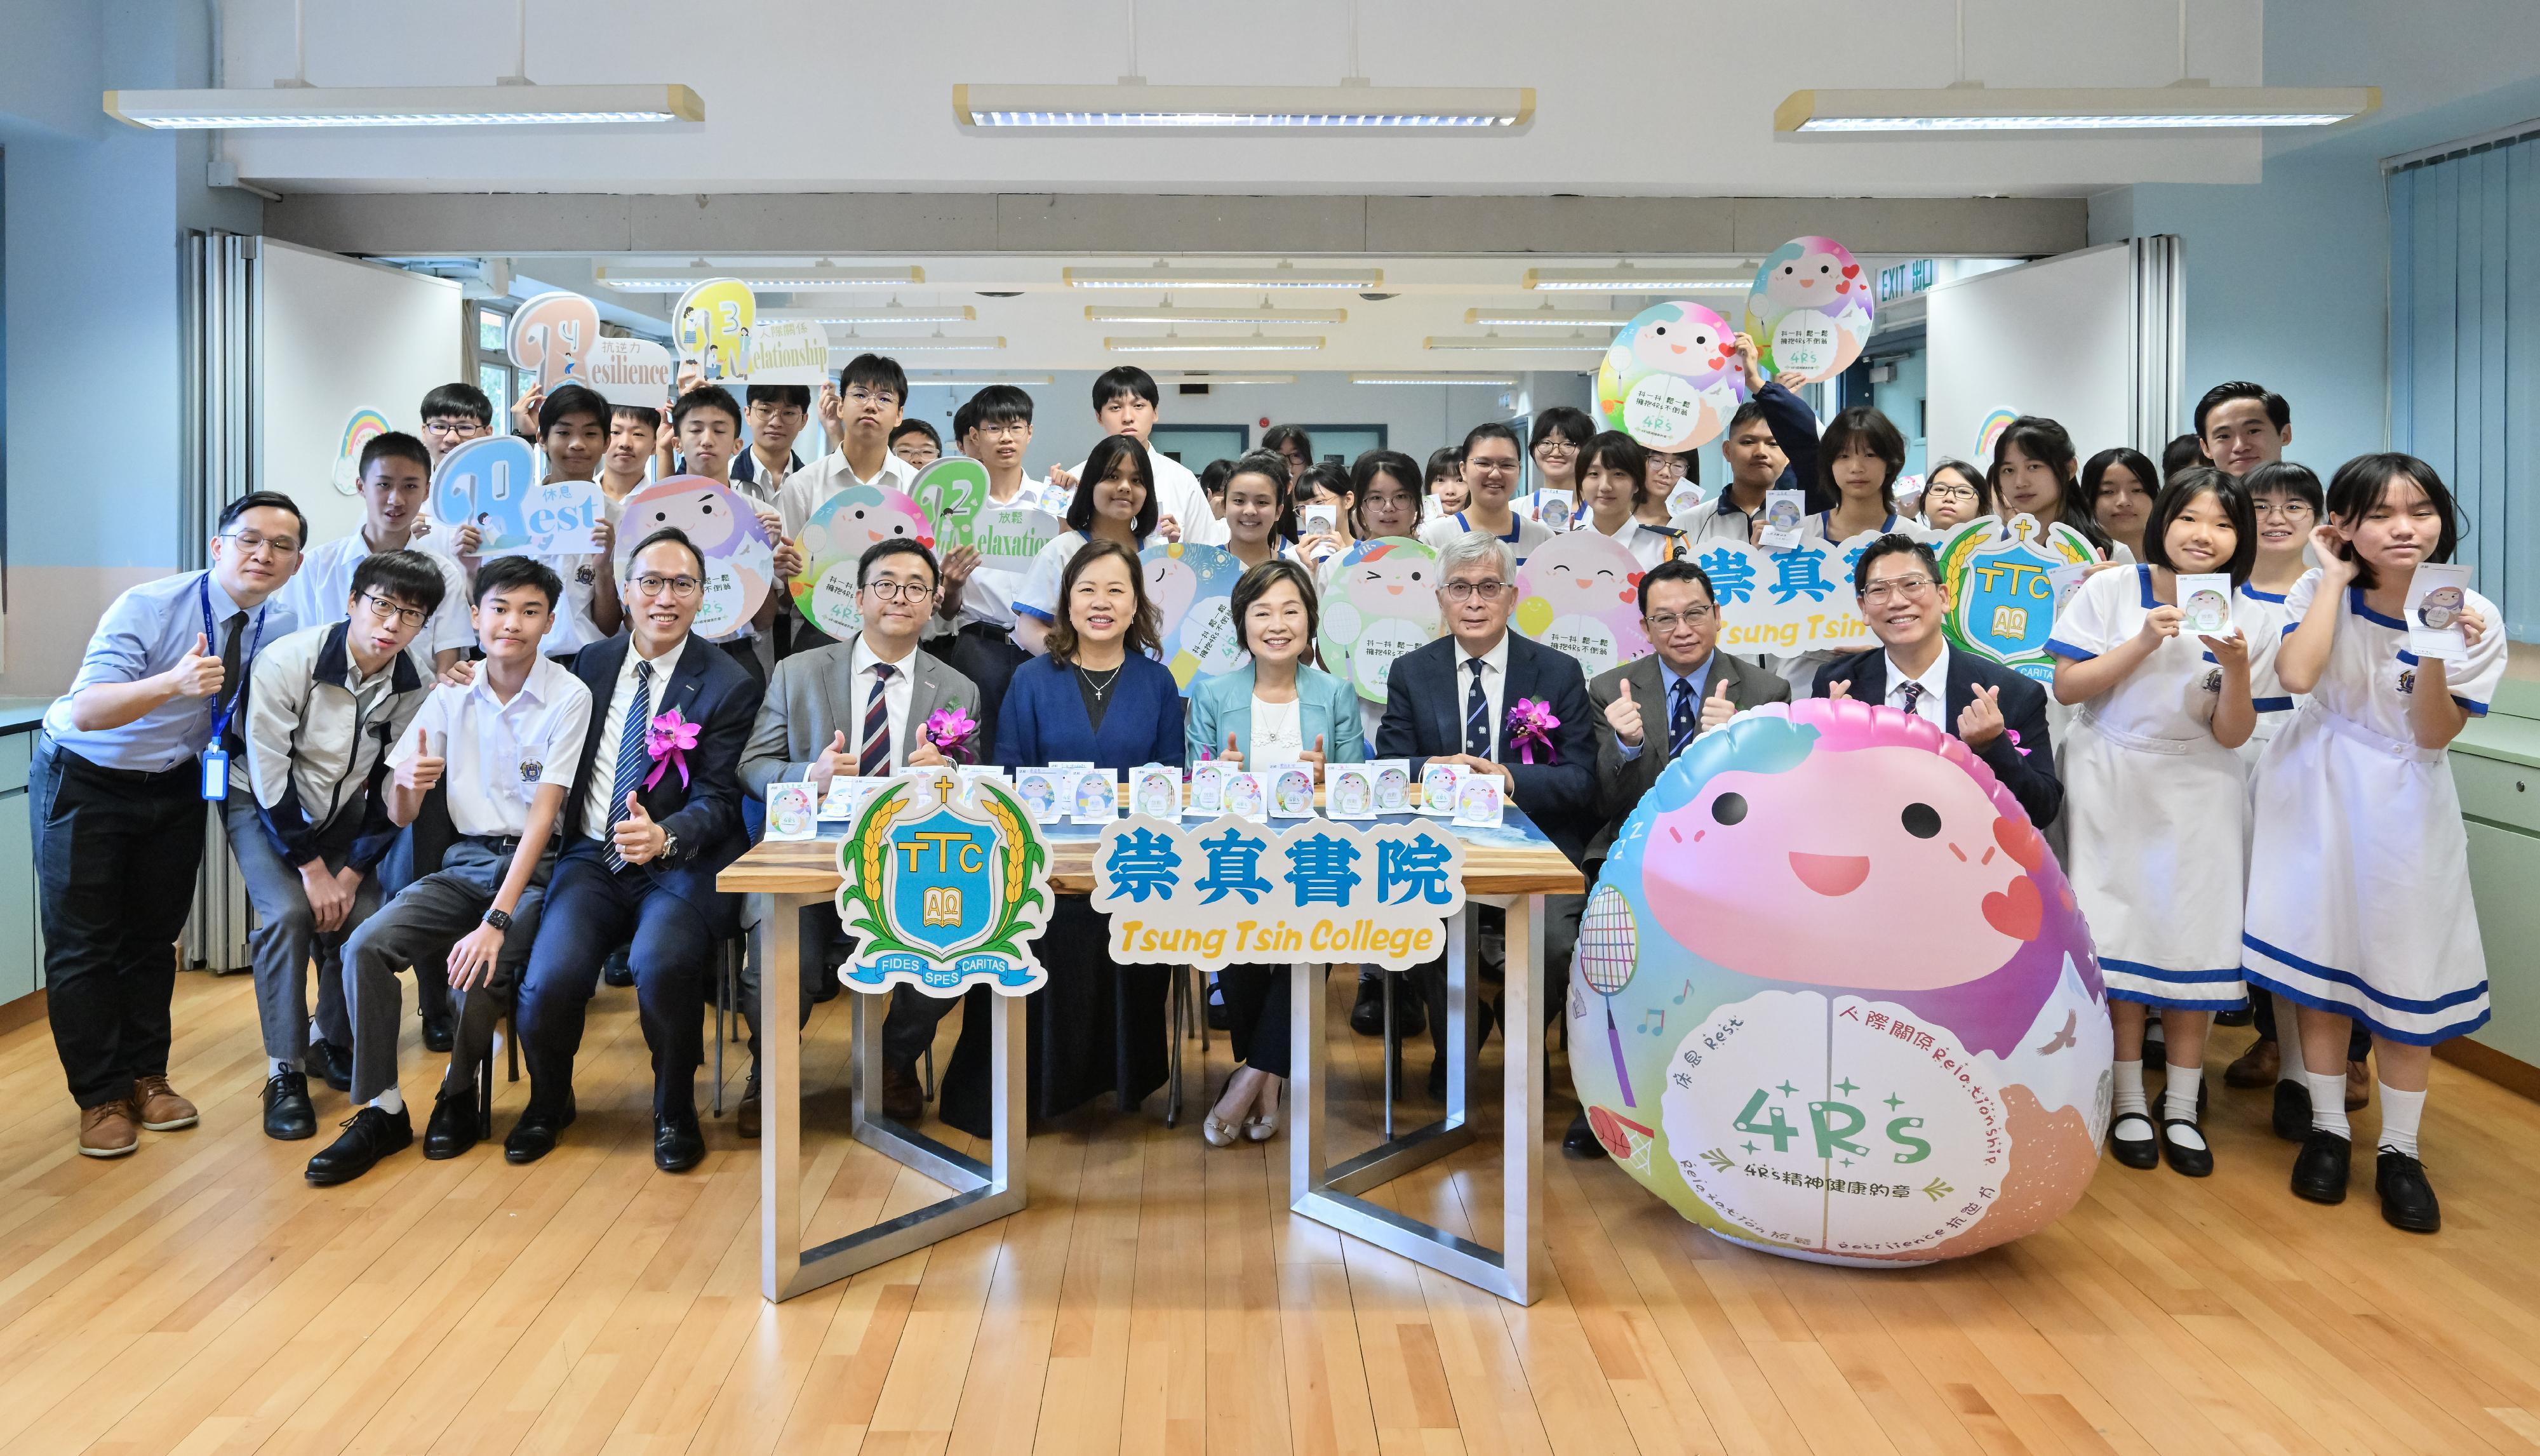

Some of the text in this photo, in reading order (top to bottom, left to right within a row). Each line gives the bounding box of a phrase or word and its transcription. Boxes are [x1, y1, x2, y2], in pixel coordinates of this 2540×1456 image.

[1882, 259, 1932, 302] EXIT 出口
[760, 323, 808, 339] 人際關係
[602, 341, 641, 354] 抗逆力
[1790, 352, 1817, 363] 4Rs
[1636, 398, 1688, 416] 擁抱4Rs不倒翁
[1638, 390, 1690, 408] 抖一抖 鬆一鬆
[1642, 416, 1672, 432] 4Rs
[542, 485, 572, 502] 休息
[998, 511, 1023, 524] 放鬆
[829, 575, 853, 590] 抖一抖
[1976, 561, 2051, 599] TTC
[1807, 613, 1866, 639] Tsin
[1193, 631, 1210, 654] 抖一抖
[1367, 639, 1391, 648] 抖一抖
[1551, 634, 1608, 646] 抖一抖 鬆一鬆
[1367, 648, 1409, 657] 擁抱4Rs不
[2021, 667, 2054, 679] CARITA
[897, 832, 984, 874] TTC
[1106, 826, 1453, 908] 崇真書院
[1121, 919, 1433, 959] Tsung Tsin College
[881, 958, 919, 972] FIDES
[961, 959, 1006, 972] CARITAS
[925, 971, 959, 985] SPES
[1673, 1017, 1744, 1090] 休息 Rest
[1839, 1005, 2002, 1165] 人際關係 Relationship
[1732, 1088, 1932, 1165] 4Rs
[1680, 1159, 1765, 1233] Relaxation
[1945, 1186, 1996, 1229] 抗逆力
